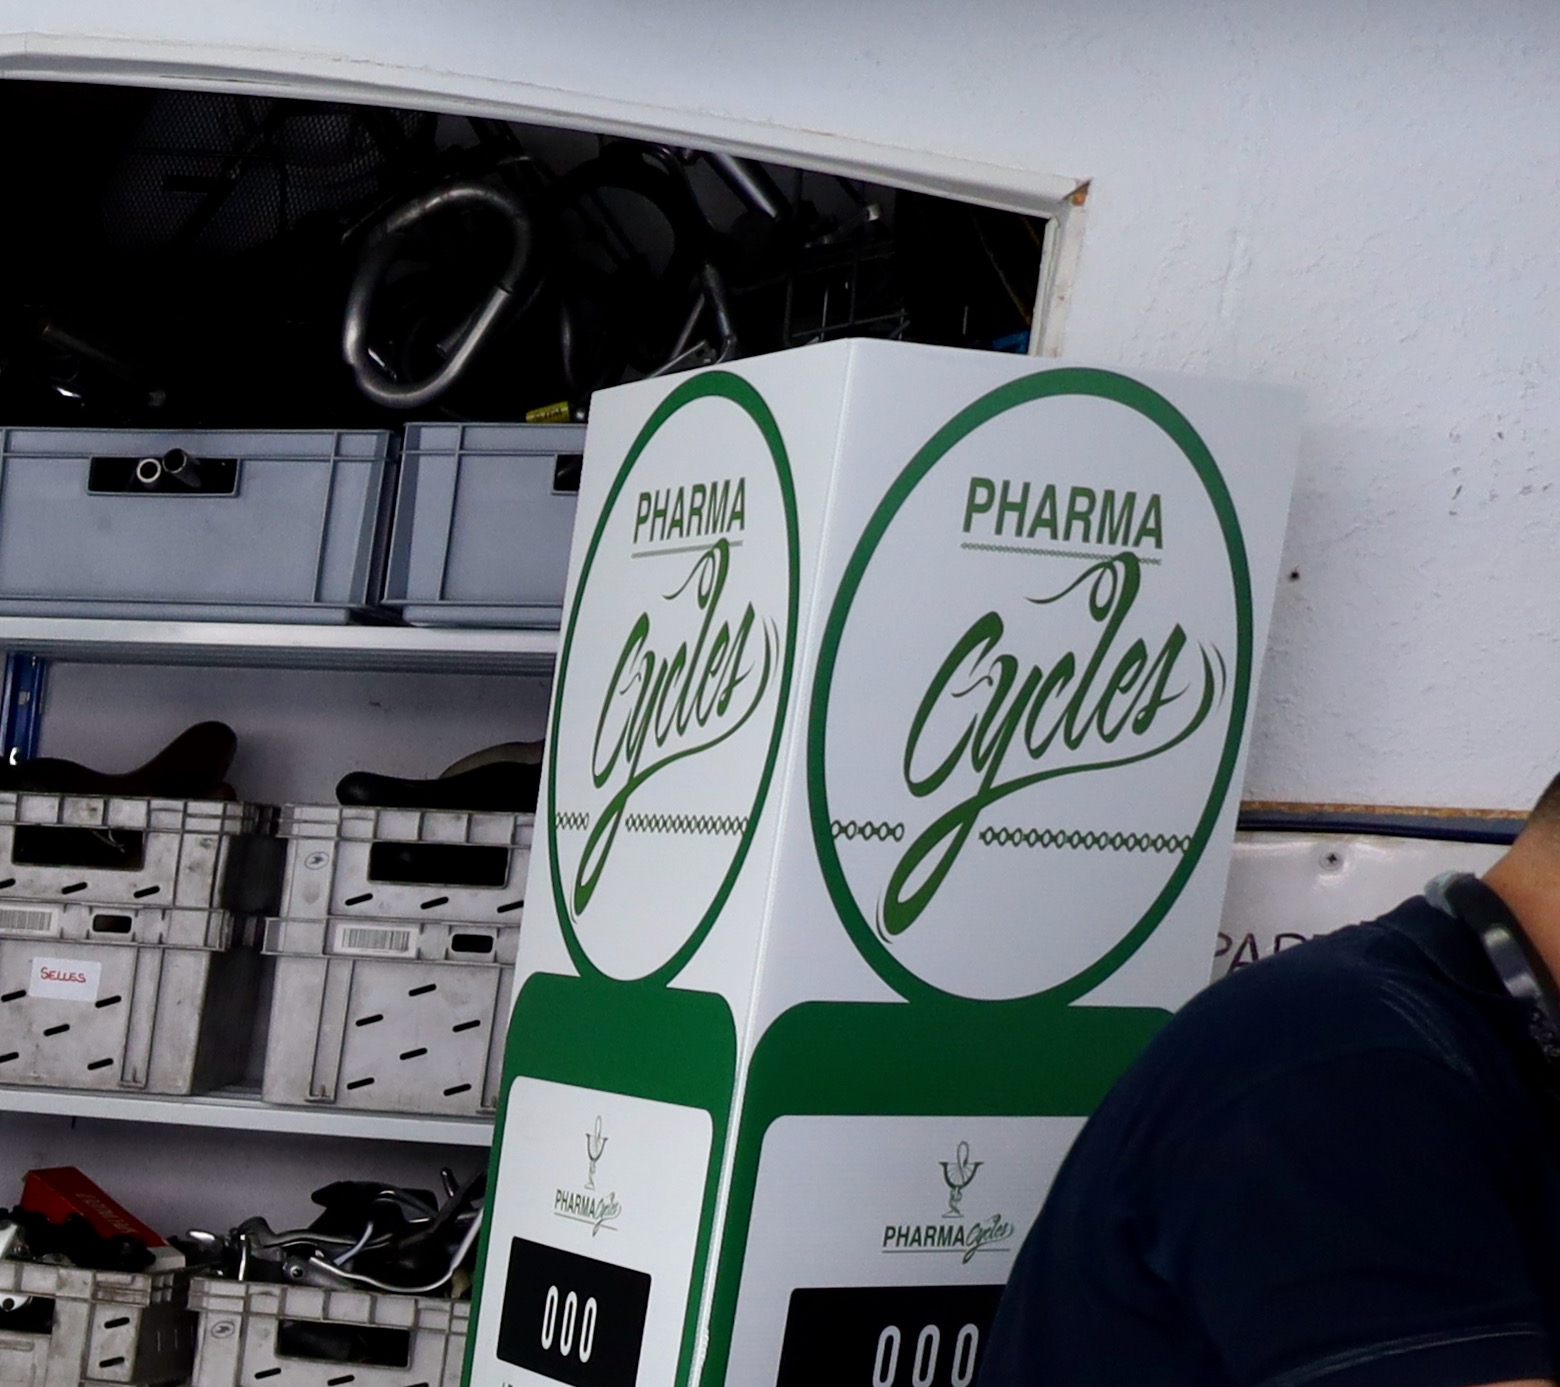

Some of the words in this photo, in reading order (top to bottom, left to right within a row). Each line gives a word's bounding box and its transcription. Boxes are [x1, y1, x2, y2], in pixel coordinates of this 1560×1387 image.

[632, 474, 748, 545] PHARMA
[964, 476, 1166, 550] PHARMA
[576, 538, 778, 916] Cycles
[885, 552, 1228, 940] Cycles
[40, 967, 87, 983] SELLES
[542, 1285, 598, 1364] 000
